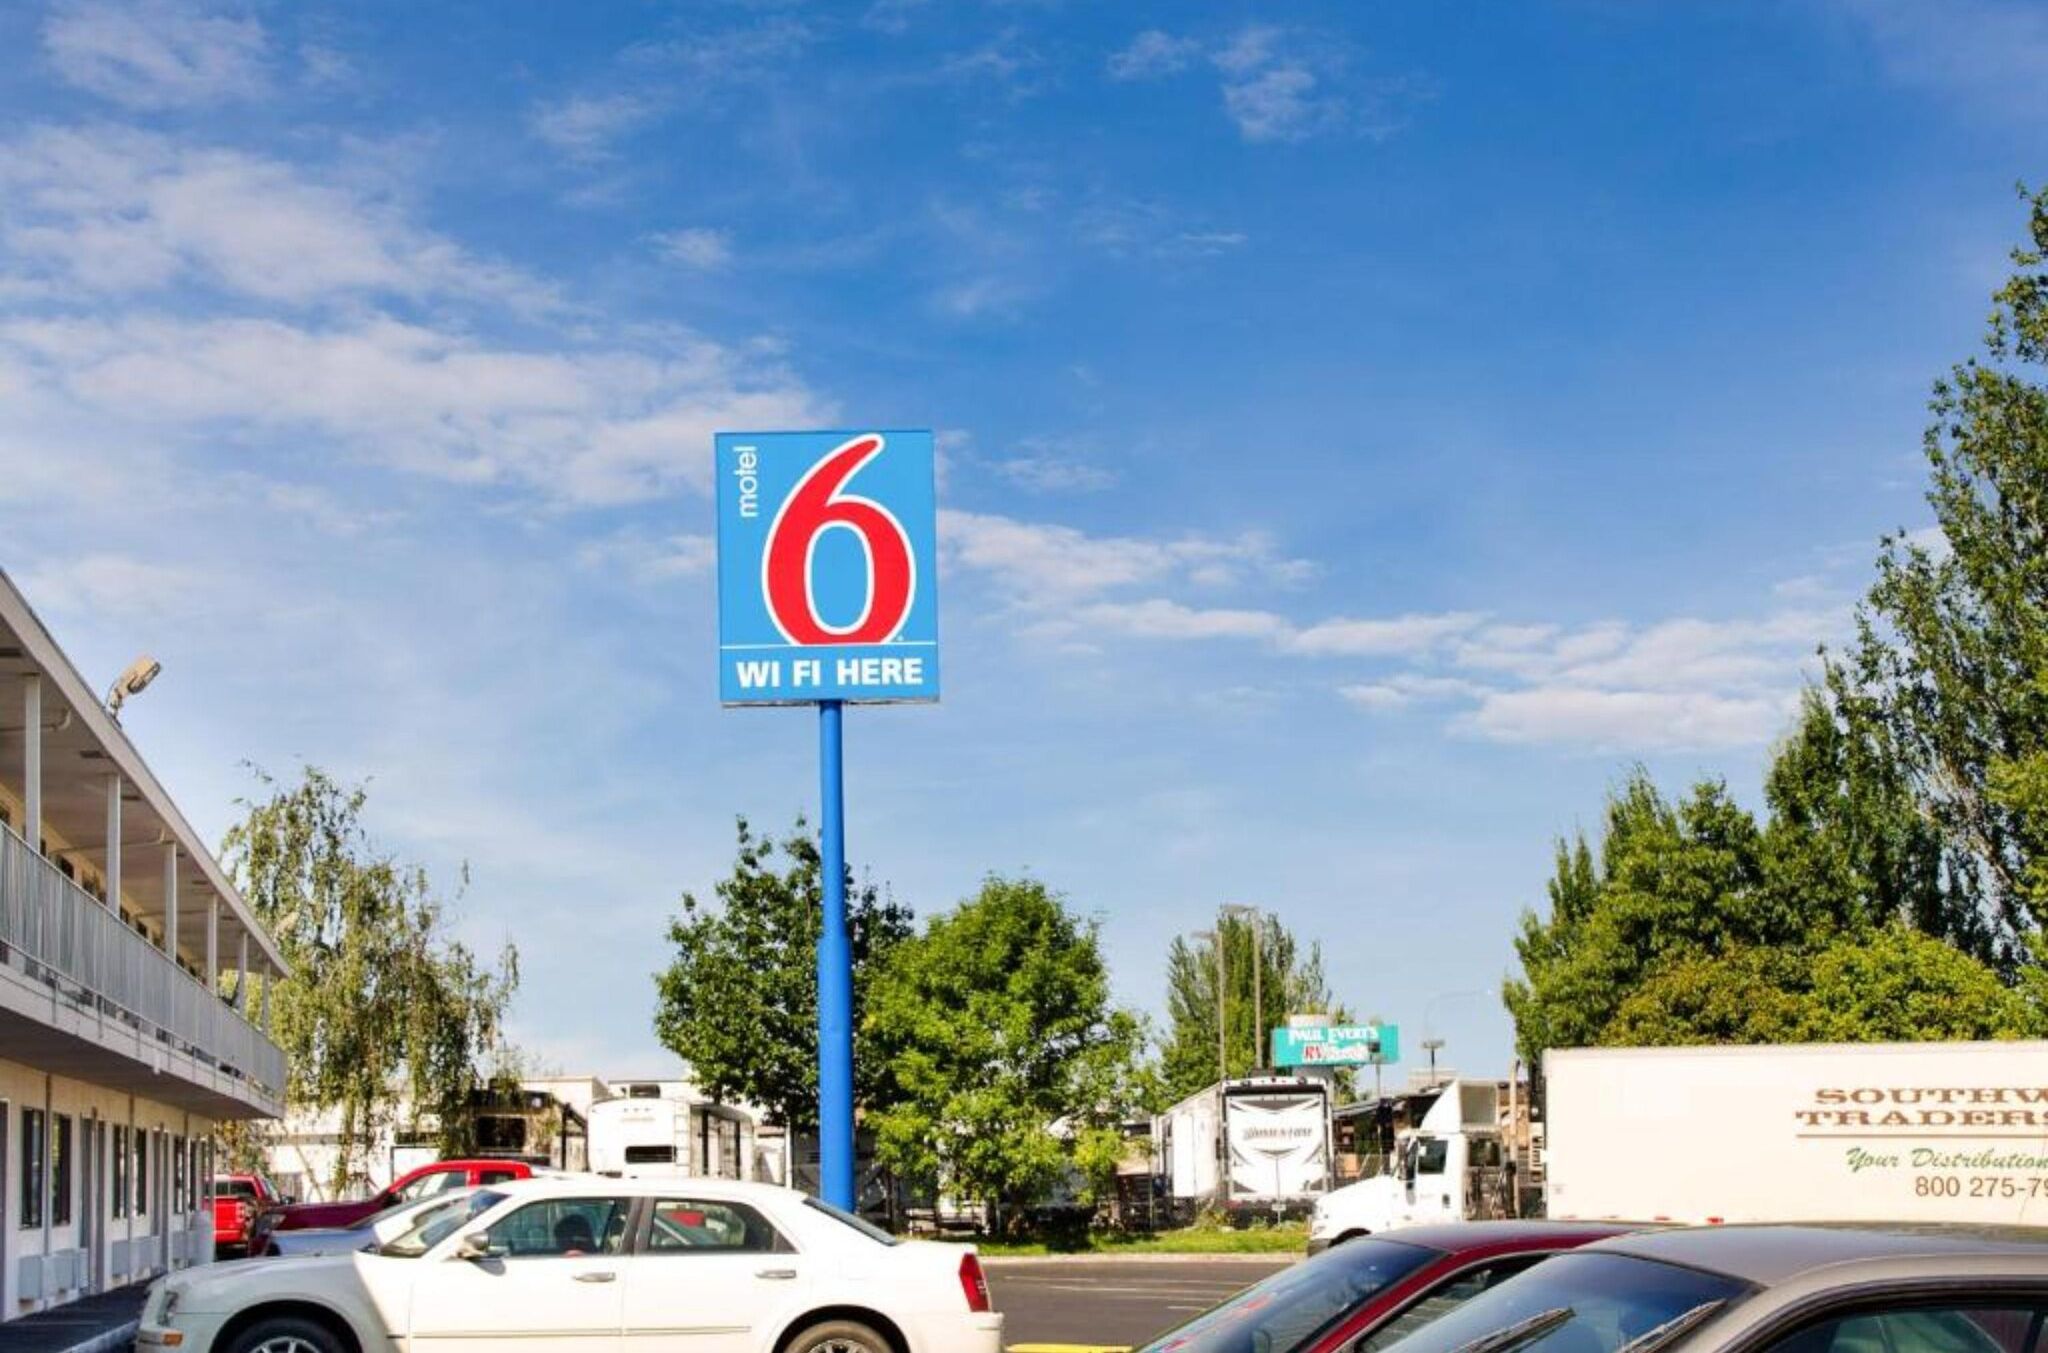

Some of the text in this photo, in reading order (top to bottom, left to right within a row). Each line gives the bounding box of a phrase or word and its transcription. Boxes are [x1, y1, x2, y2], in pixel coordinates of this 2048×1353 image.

[733, 446, 758, 518] motel
[761, 433, 917, 647] 6
[736, 658, 923, 688] WI FI HERE
[1795, 1110, 2048, 1126] TRADER
[1845, 1147, 2048, 1172] Your Distribution
[1915, 1176, 1961, 1198] 800
